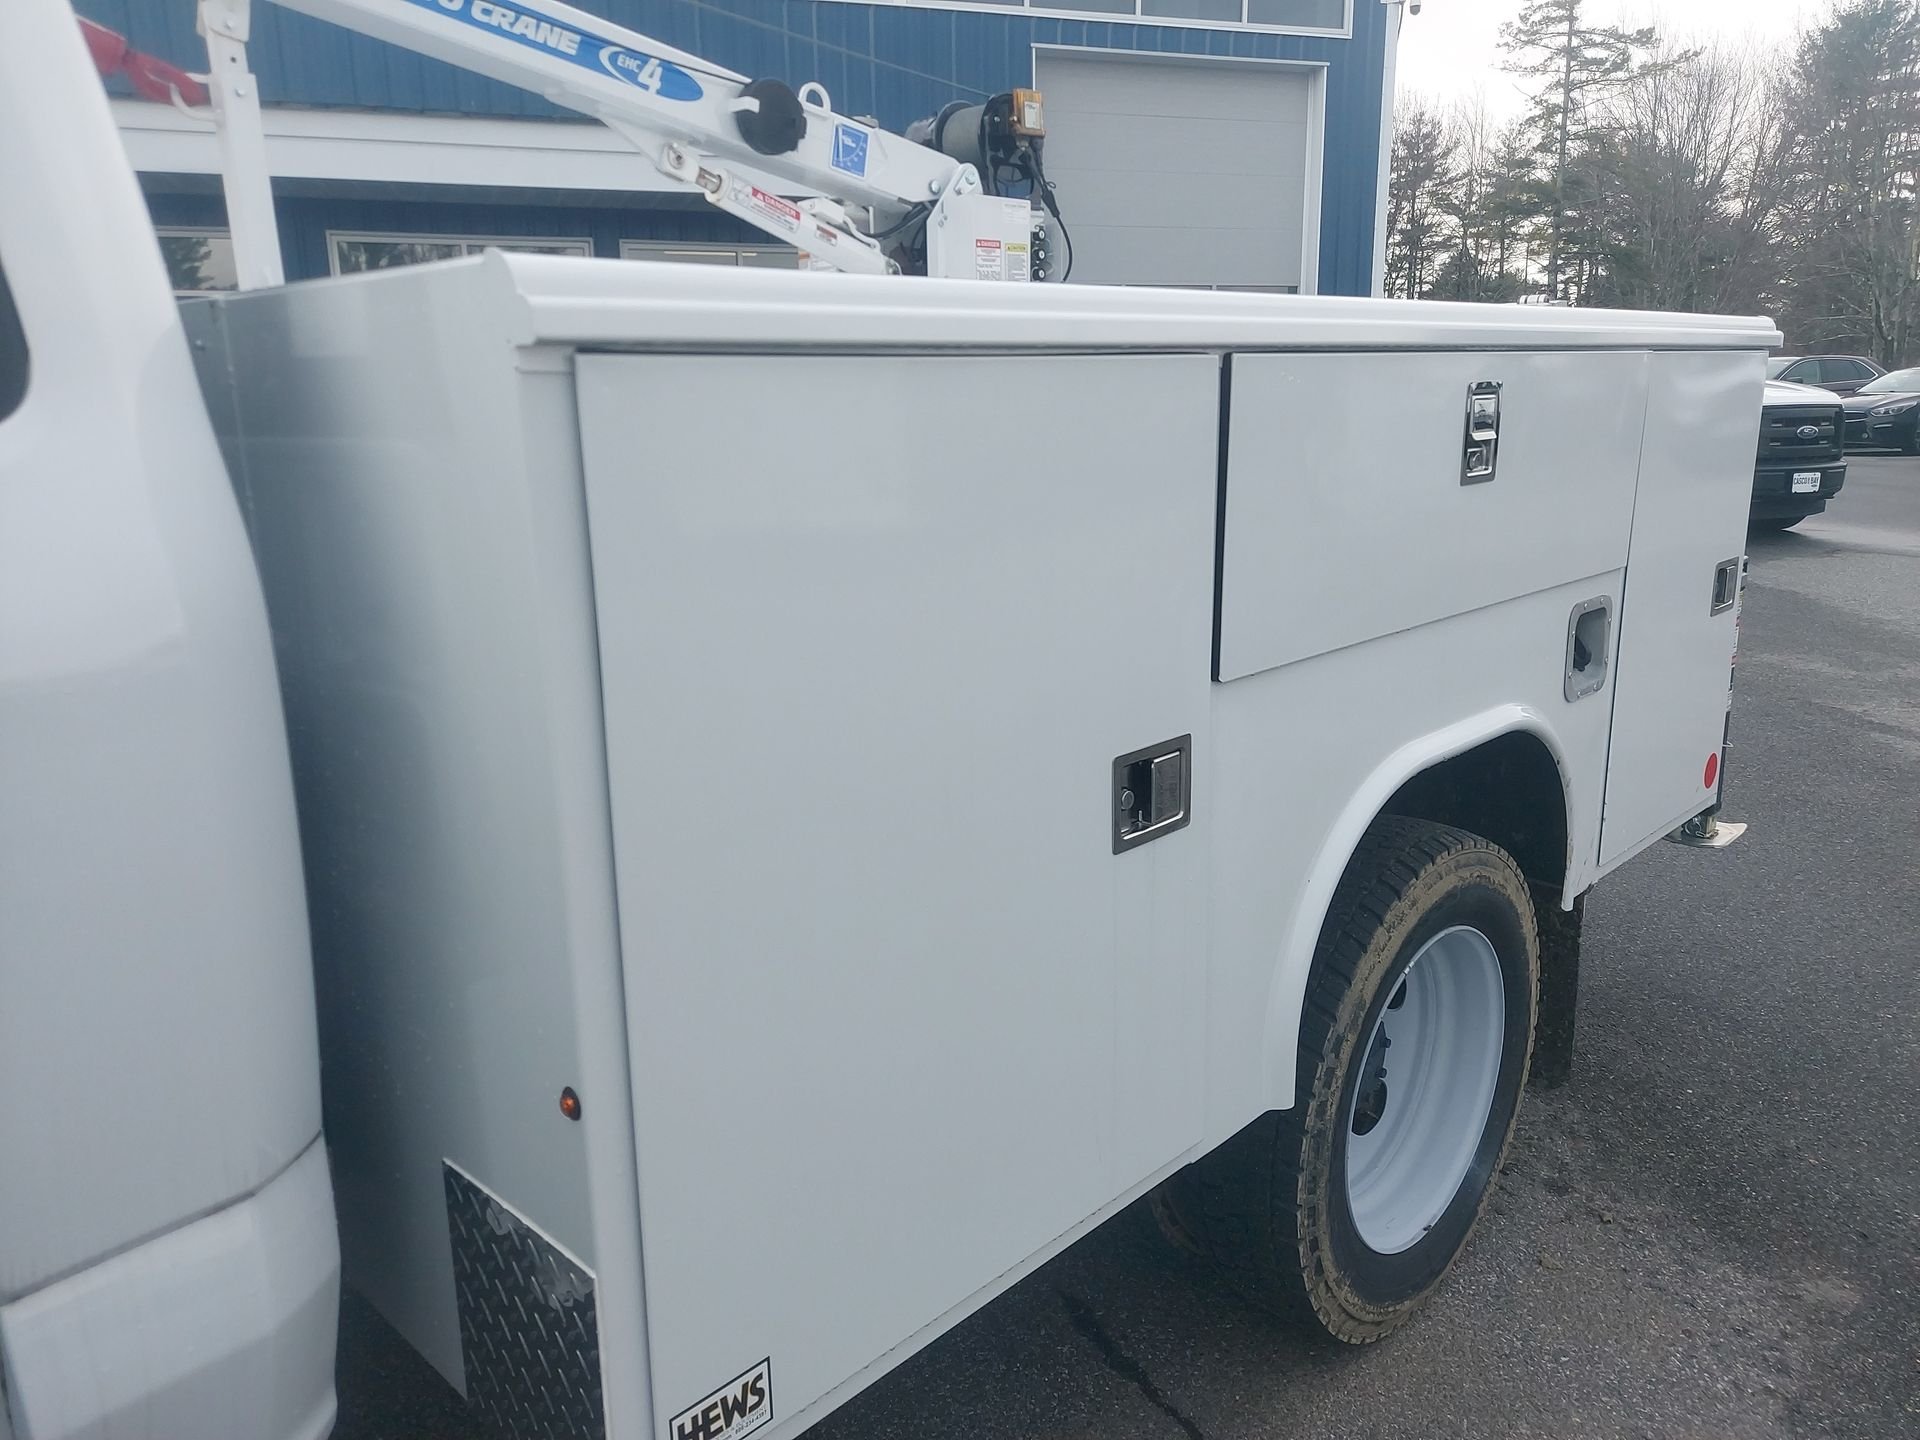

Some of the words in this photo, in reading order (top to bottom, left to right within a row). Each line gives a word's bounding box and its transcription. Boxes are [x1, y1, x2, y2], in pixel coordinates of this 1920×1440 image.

[470, 0, 582, 56] CRANE
[617, 53, 642, 73] EHC
[637, 57, 663, 96] 4
[677, 1371, 765, 1440] HEWS
